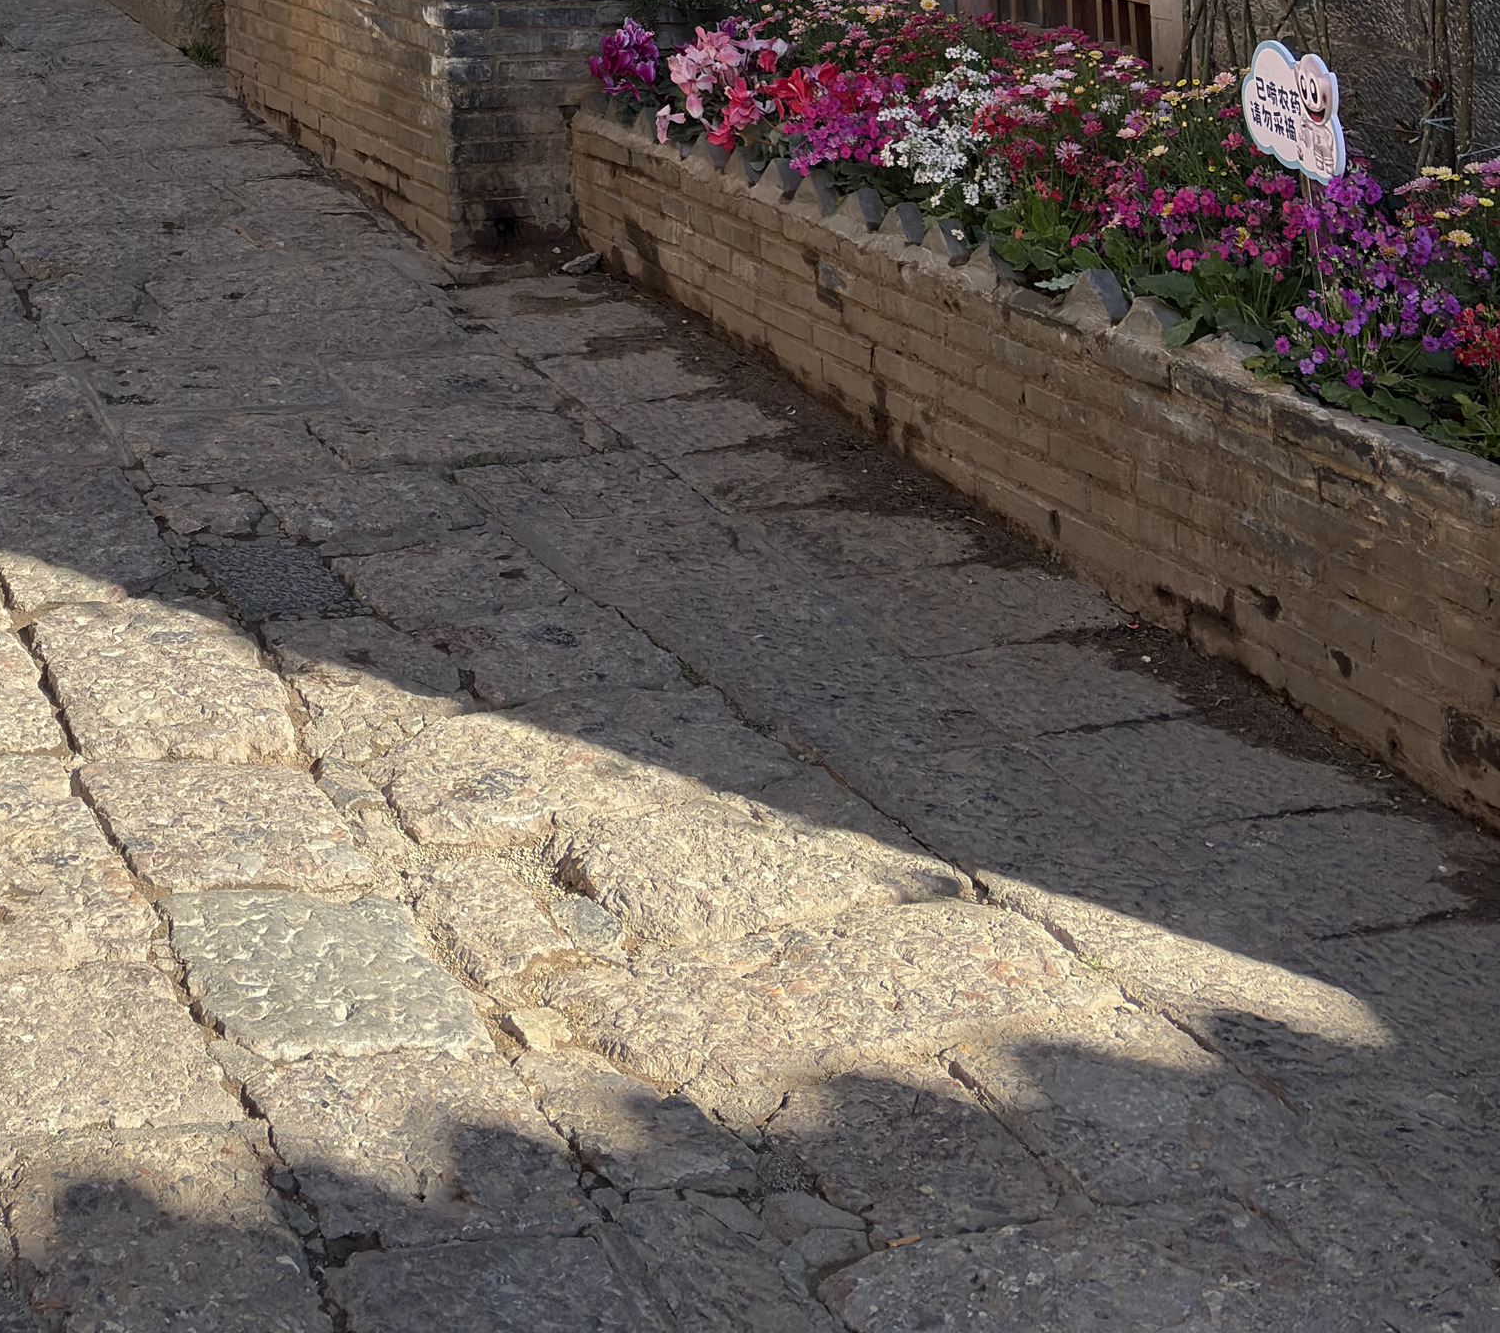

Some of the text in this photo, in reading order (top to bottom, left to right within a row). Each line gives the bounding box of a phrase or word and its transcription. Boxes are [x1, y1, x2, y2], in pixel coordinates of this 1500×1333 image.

[1255, 76, 1302, 117] 已喷农药
[1249, 100, 1298, 143] 请勿采摘
